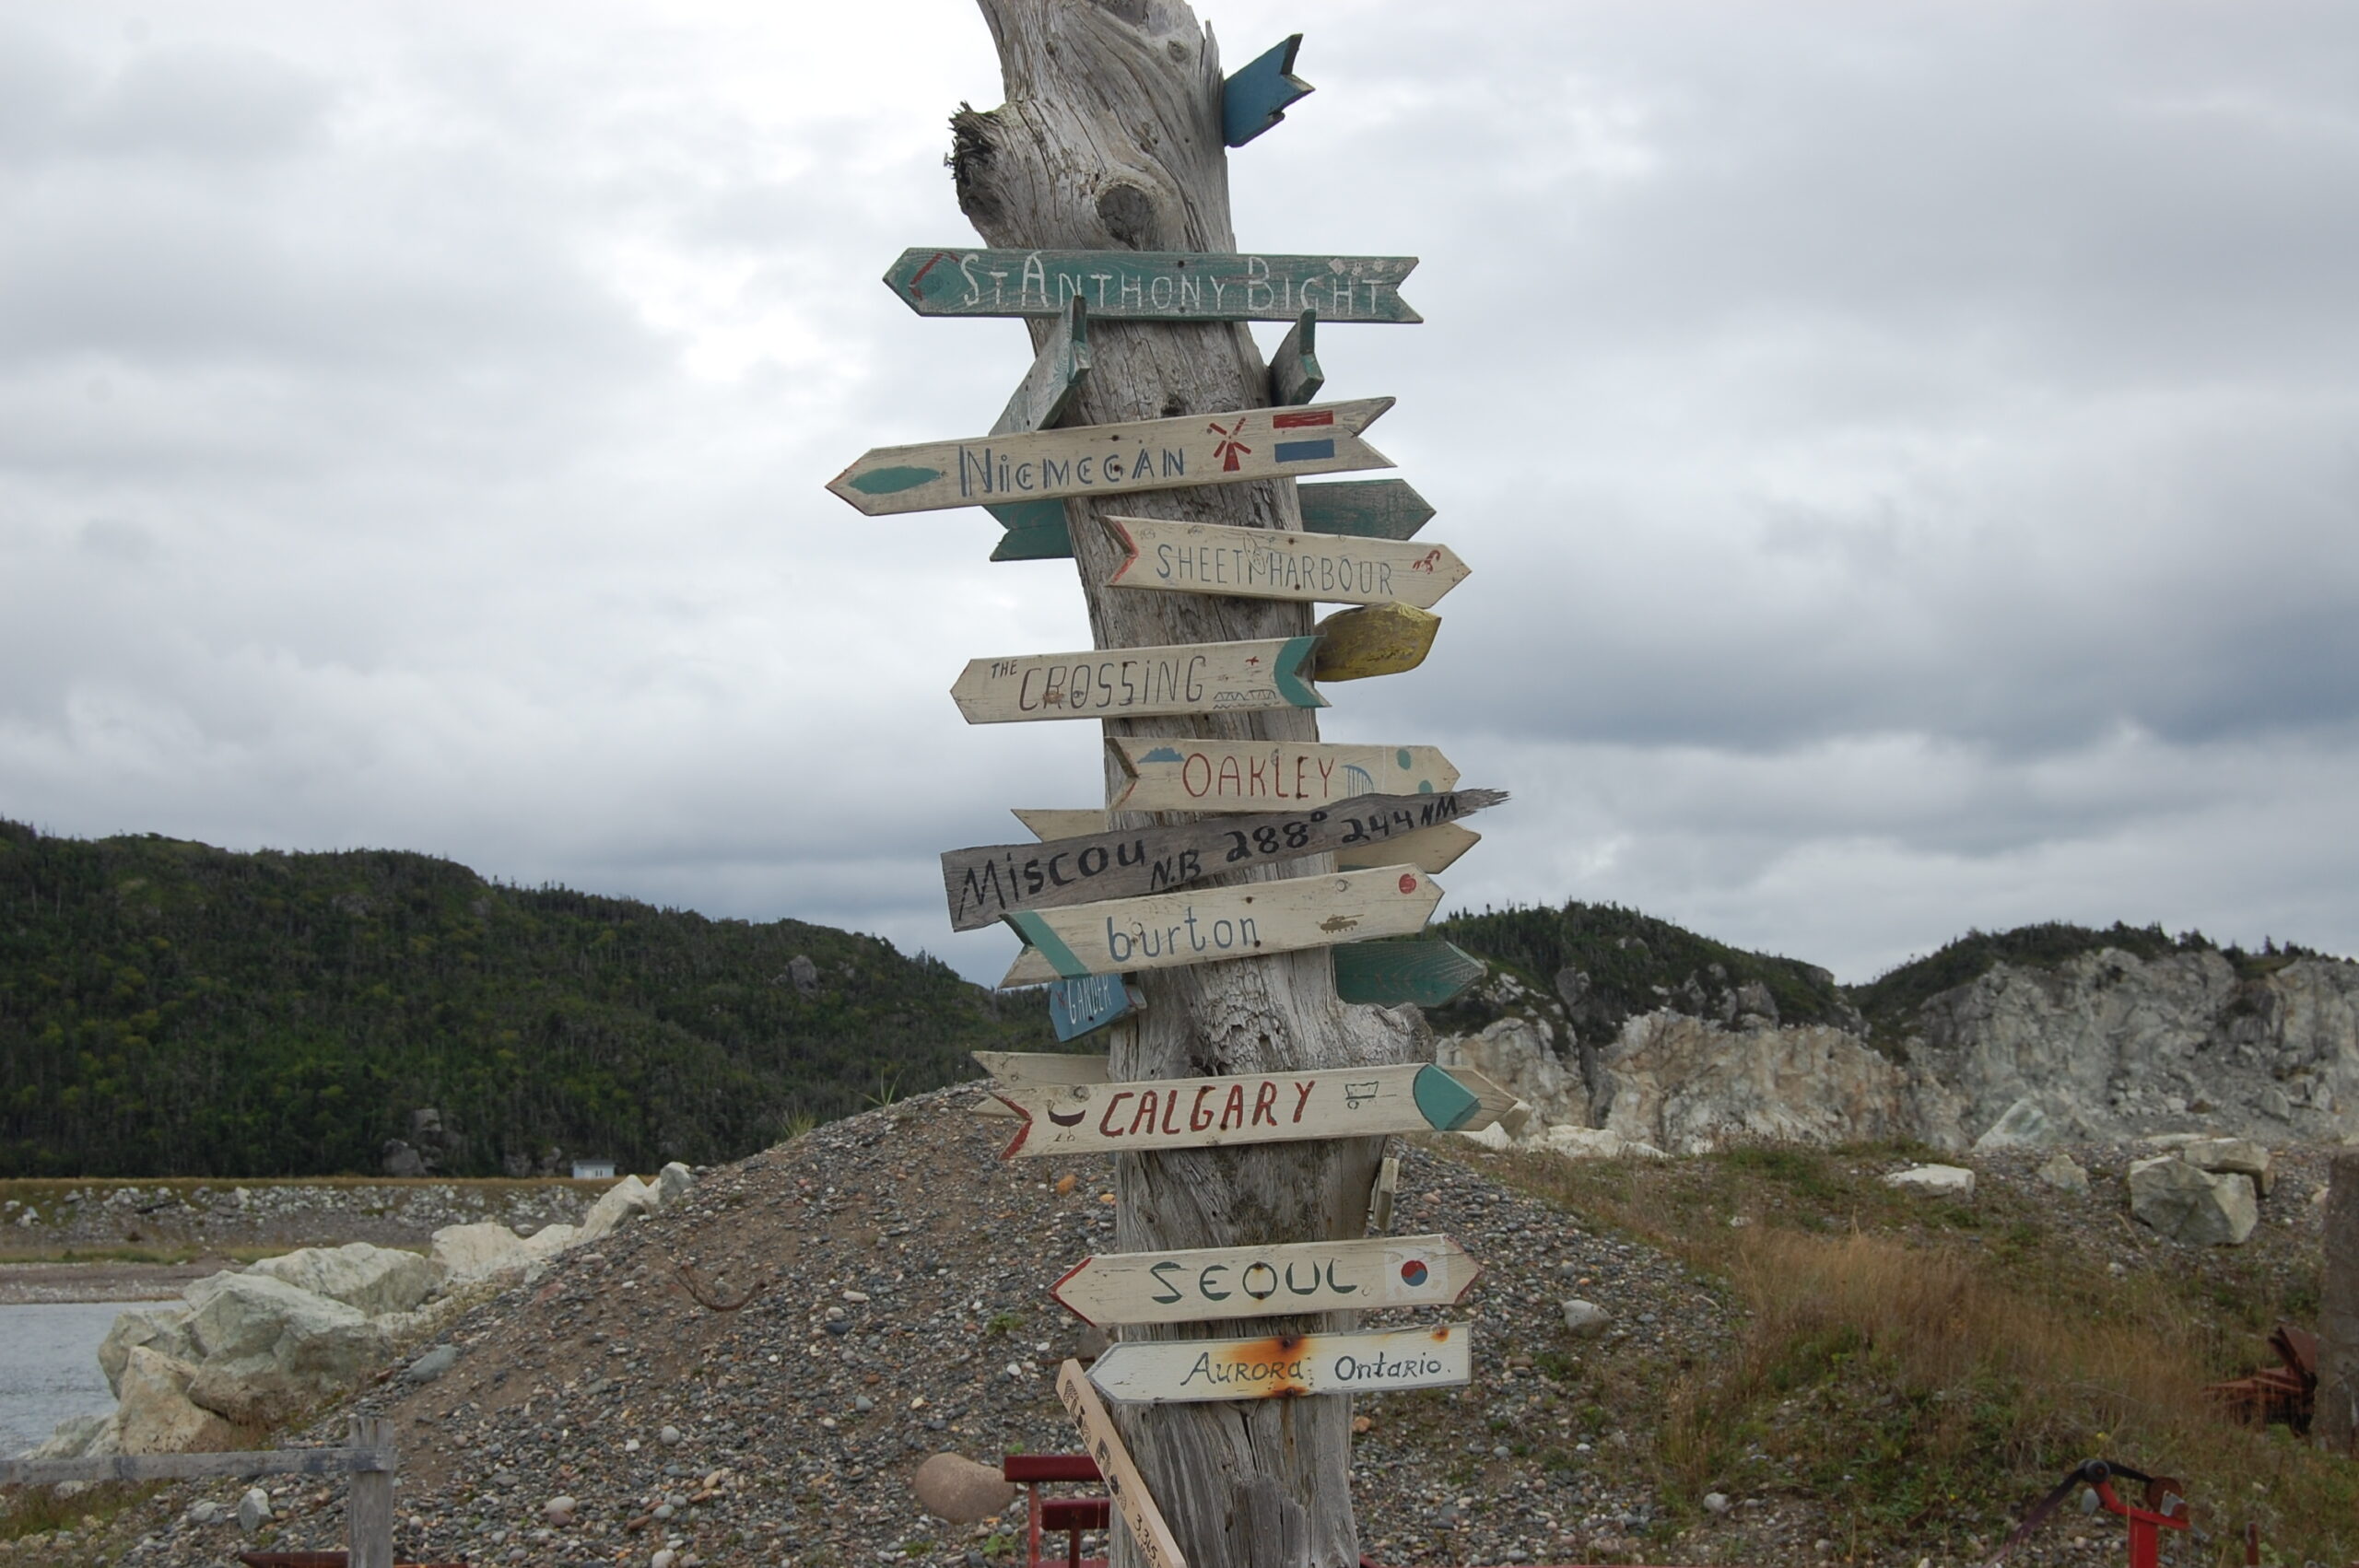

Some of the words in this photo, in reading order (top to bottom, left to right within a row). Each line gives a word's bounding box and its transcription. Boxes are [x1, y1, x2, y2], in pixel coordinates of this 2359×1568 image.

[1248, 256, 1383, 315] BIGHT
[992, 659, 1017, 679] THE
[1182, 752, 1334, 799] OAKLEY
[1341, 810, 1414, 843] 244
[1420, 795, 1458, 826] NM
[1107, 907, 1261, 962] burton
[1067, 971, 1112, 1025] GANDER
[1099, 1080, 1316, 1137] CALGARY
[1149, 1258, 1357, 1305] SEOUL
